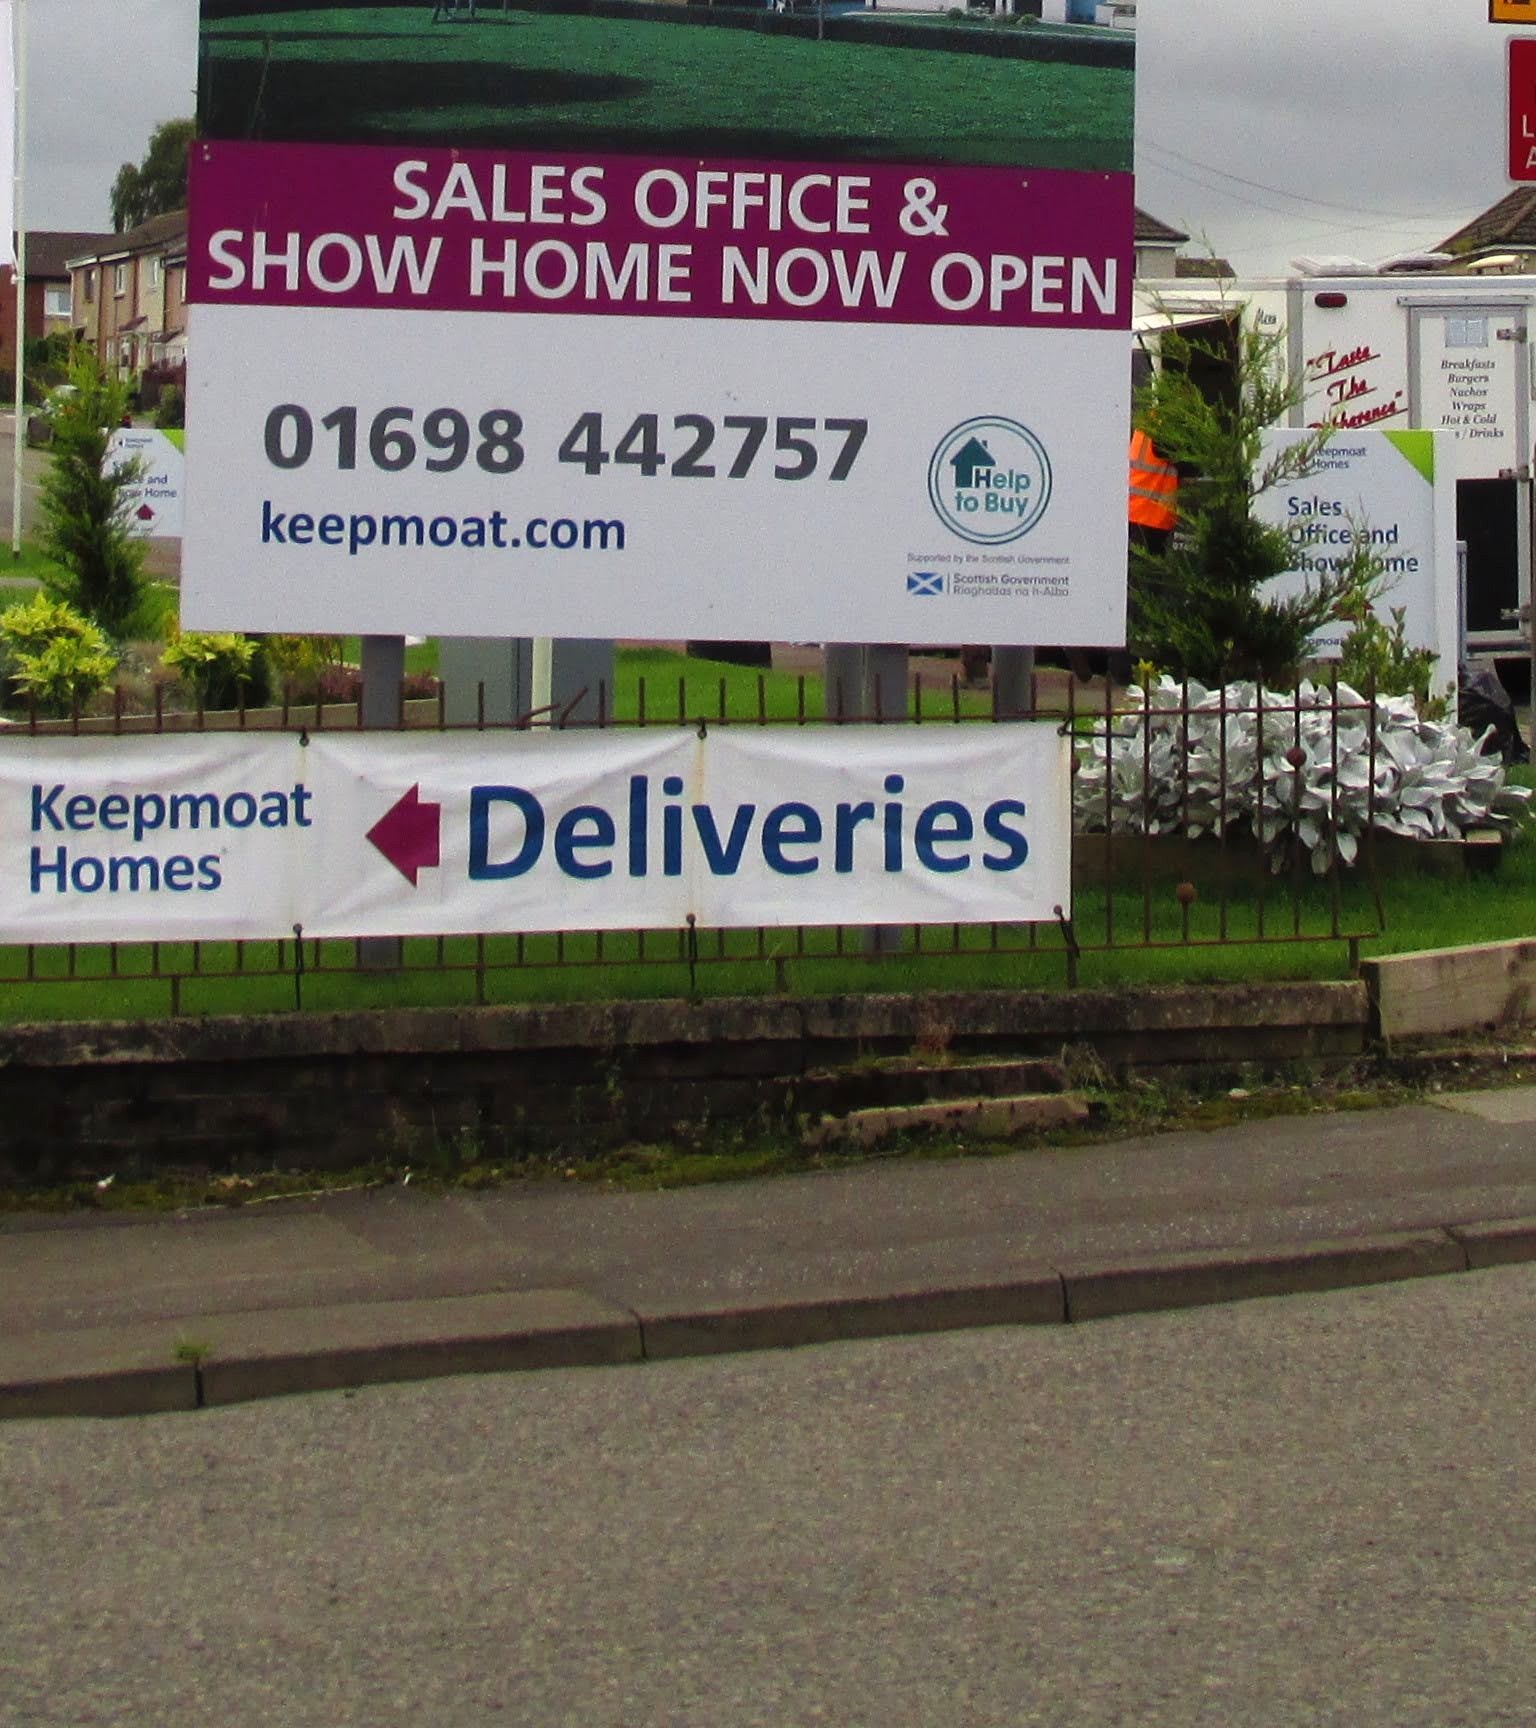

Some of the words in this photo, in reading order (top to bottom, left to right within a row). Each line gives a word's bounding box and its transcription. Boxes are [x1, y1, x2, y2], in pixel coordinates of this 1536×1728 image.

[392, 159, 607, 226] SALES
[634, 166, 872, 235] OFFICE
[898, 177, 951, 238] &
[207, 229, 443, 296] SHOW
[469, 238, 693, 303] HOME
[719, 246, 907, 311] NOW
[930, 253, 1119, 316] OPEN
[1441, 358, 1495, 371] Breakfasts
[1327, 375, 1369, 401] The
[1448, 373, 1488, 385] Burgers
[1450, 386, 1487, 397] Nachos
[1452, 400, 1485, 412] Wraps
[1441, 415, 1459, 425] Hot
[1463, 414, 1470, 424] &
[1472, 413, 1496, 424] Cold
[262, 402, 525, 473] 01698
[557, 412, 869, 480] 442757
[1469, 427, 1504, 439] Drinks
[1313, 458, 1349, 468] Homes
[147, 474, 167, 484] and
[975, 468, 1031, 493] Help
[144, 487, 177, 497] Home
[955, 490, 978, 511] to
[984, 492, 1029, 517] Buy
[1287, 495, 1341, 516] Sales
[261, 501, 627, 556] keepmoat.com
[1359, 524, 1398, 544] and
[907, 553, 950, 563] Supported
[953, 553, 963, 564] by
[966, 553, 978, 563] the
[1017, 555, 1069, 565] Government
[953, 573, 997, 584] Scottish
[1001, 574, 1068, 585] Government
[29, 780, 313, 838] Keepmoat
[468, 773, 1030, 881] Deliveries
[29, 845, 223, 895] Homes
